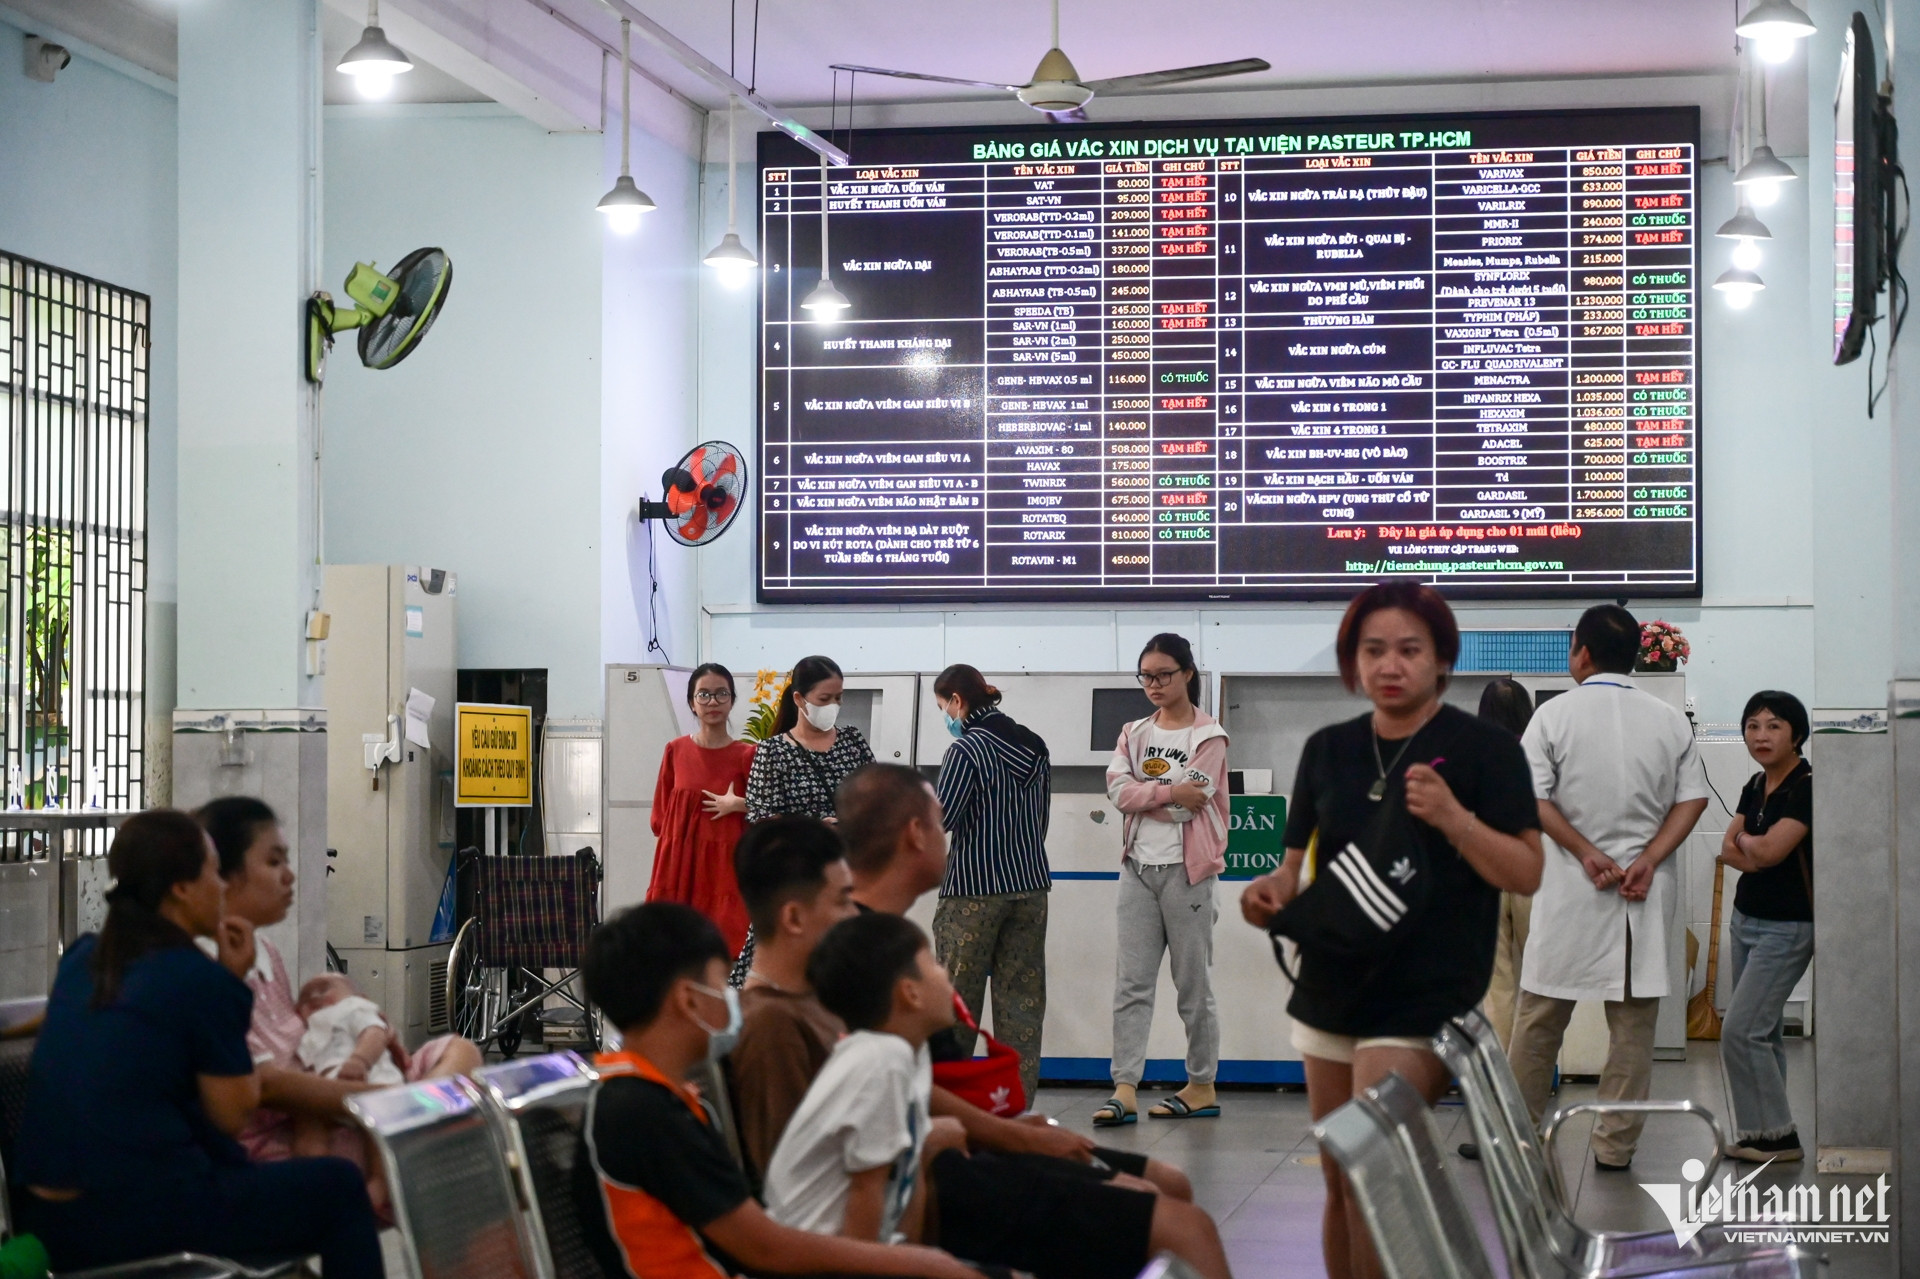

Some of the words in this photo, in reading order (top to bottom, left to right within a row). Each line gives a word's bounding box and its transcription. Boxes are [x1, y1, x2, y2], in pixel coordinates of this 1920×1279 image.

[974, 141, 1024, 158] BẢNG
[1030, 139, 1061, 157] GIÁ
[1109, 141, 1138, 155] XIN
[1145, 139, 1188, 159] DỊCH
[1194, 138, 1218, 156] VỤ
[1224, 137, 1253, 156] TẠI
[1259, 135, 1301, 154] VIỆN
[1308, 134, 1395, 150] PASTEUR
[1400, 131, 1472, 148] TP.HCM
[1221, 161, 1239, 170] STT
[1583, 166, 1622, 176] 850.000
[769, 173, 786, 181] STT
[1117, 179, 1149, 187] 80.000
[1583, 182, 1622, 191] 633.000
[775, 188, 779, 196] 1
[1118, 194, 1149, 202] 95.000
[1225, 193, 1236, 202] 10
[1583, 199, 1623, 208] 890.000
[1112, 211, 1149, 219] 209.000
[1583, 217, 1623, 226] 240.000
[1632, 215, 1646, 225] CÓ
[1649, 215, 1687, 226] THUỐC
[1113, 228, 1149, 237] 141.000
[1584, 235, 1623, 244] 374.000
[1112, 246, 1149, 254] 337.000
[1225, 245, 1236, 253] 11
[1584, 254, 1623, 263] 215.000
[773, 264, 780, 272] 3
[1113, 265, 1149, 273] 180.000
[1584, 276, 1623, 286] 980,000
[1112, 286, 1149, 295] 245.000
[1225, 292, 1236, 300] 12
[1577, 296, 1623, 305] 1.230,000
[1468, 298, 1522, 307] PREVENAR
[1524, 297, 1535, 306] 13
[1112, 305, 1149, 314] 245.000
[1584, 311, 1623, 320] 233.000
[1113, 320, 1149, 328] 160.000
[1225, 318, 1236, 327] 13
[1584, 326, 1623, 335] 367.000
[1112, 335, 1149, 344] 250.000
[774, 342, 780, 350] 4
[1112, 351, 1149, 359] 450.000
[1226, 348, 1237, 356] 14
[1110, 375, 1147, 383] 116.000
[1161, 373, 1173, 382] CÓ
[1176, 371, 1208, 382] THUỐC
[1577, 374, 1624, 383] 1.200.000
[1225, 380, 1236, 389] 15
[1577, 392, 1624, 401] 1.035.000
[1633, 390, 1647, 400] CÓ
[1650, 390, 1687, 402] THUỐC
[774, 402, 779, 410] 5
[1113, 400, 1149, 408] 150.000
[1226, 405, 1237, 413] 16
[1577, 408, 1624, 416] 1.036.000
[1109, 422, 1147, 430] 140.000
[1584, 422, 1624, 430] 480.000
[1225, 427, 1237, 436] 17
[1584, 438, 1624, 447] 625.000
[1112, 445, 1149, 453] 508.000
[1225, 451, 1237, 459] 18
[1585, 455, 1624, 464] 700.000
[774, 456, 780, 464] 6
[1113, 461, 1149, 470] 175.000
[1225, 477, 1237, 485] 19
[1585, 472, 1624, 481] 100.000
[774, 481, 779, 489] 7
[1112, 478, 1149, 486] 560.000
[1577, 490, 1624, 499] 1.700.000
[1634, 487, 1647, 498] CÓ
[1650, 487, 1687, 498] THUỐC
[774, 499, 779, 507] 8
[1112, 495, 1149, 504] 675.000
[1225, 502, 1237, 511] 20
[1576, 508, 1624, 517] 2.956.000
[1112, 514, 1149, 522] 640.000
[1112, 531, 1149, 539] 810.000
[1159, 528, 1172, 538] CÓ
[1175, 527, 1210, 538] THUỐC
[774, 541, 779, 549] 9
[1112, 556, 1149, 564] 450.000
[627, 672, 637, 681] 5
[494, 759, 505, 778] THEO
[506, 759, 515, 779] QUY
[1224, 853, 1281, 868] TION
